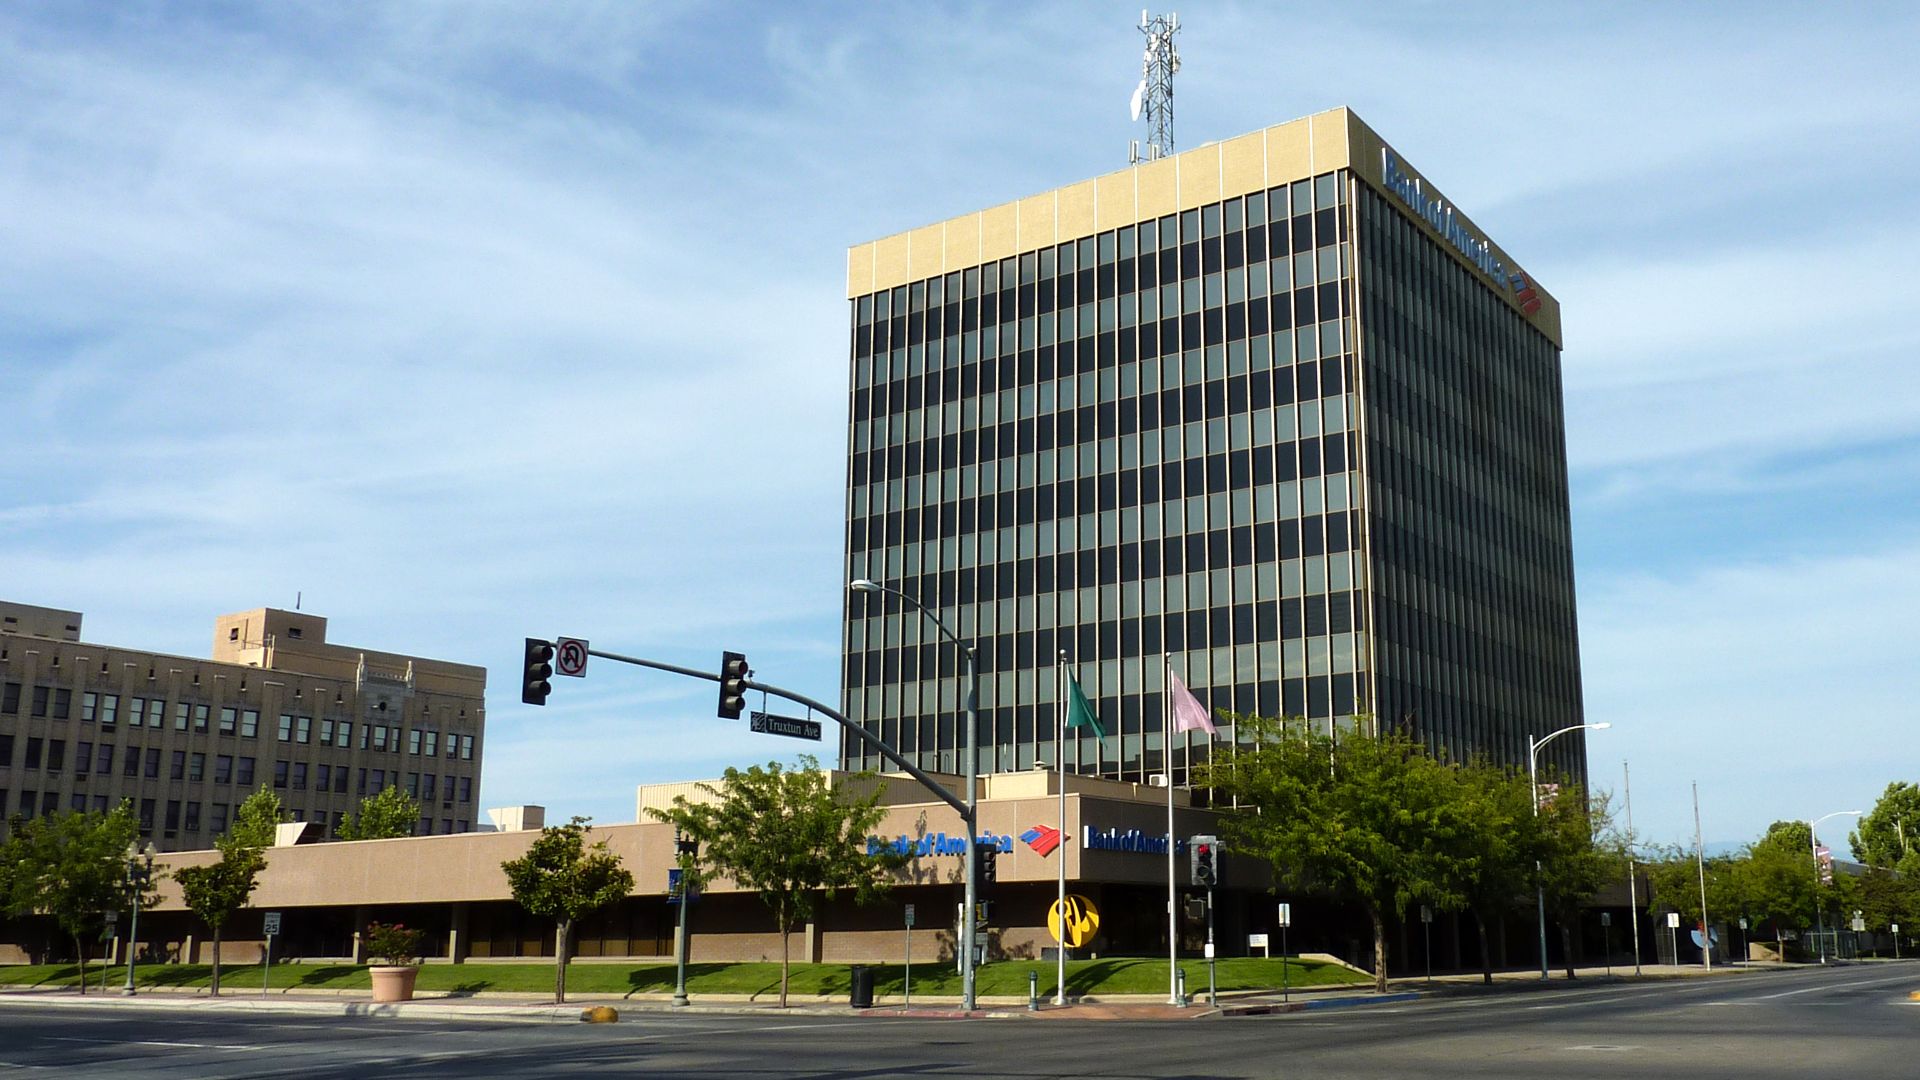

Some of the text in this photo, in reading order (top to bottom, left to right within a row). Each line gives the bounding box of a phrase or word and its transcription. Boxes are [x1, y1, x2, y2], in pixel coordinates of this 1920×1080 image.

[1382, 147, 1426, 220] Bank
[1445, 207, 1508, 291] America
[768, 718, 819, 737] Truxtun Ave
[866, 834, 914, 857] Bnk
[934, 832, 1013, 857] Amrica
[1083, 825, 1120, 850] Bank
[1133, 829, 1185, 856] Ameria
[265, 923, 278, 933] 25
